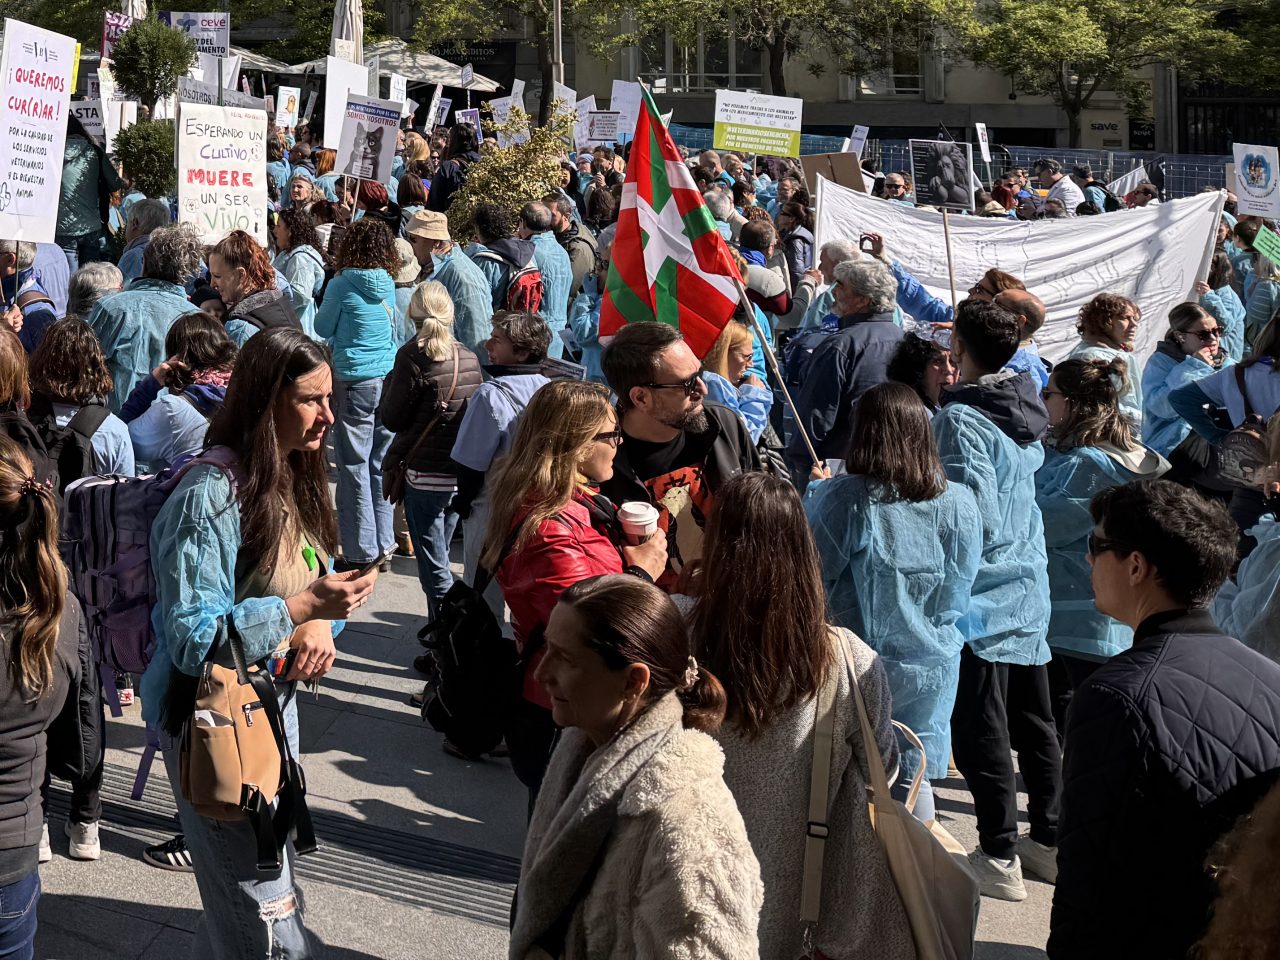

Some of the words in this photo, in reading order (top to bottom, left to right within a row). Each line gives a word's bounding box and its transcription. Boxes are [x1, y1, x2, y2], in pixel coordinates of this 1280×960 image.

[201, 18, 226, 28] ceve
[347, 111, 365, 120] SOMOS
[366, 116, 397, 127] NOSOTROS
[186, 117, 243, 139] ESPERANDO
[249, 131, 263, 141] UN
[1090, 122, 1119, 131] save
[9, 126, 19, 136] POR
[20, 128, 27, 138] LA
[28, 130, 47, 141] CALIDAD
[47, 134, 53, 142] DE
[12, 142, 22, 152] LOS
[23, 144, 47, 156] SERVICIOS
[11, 157, 44, 170] VETERINARIOS
[13, 172, 18, 180] EL
[20, 173, 45, 186] BIENESTAR
[187, 168, 253, 187] MUERE
[16, 188, 34, 198] ANIMAL
[200, 192, 217, 204] UN
[224, 193, 250, 207] SER
